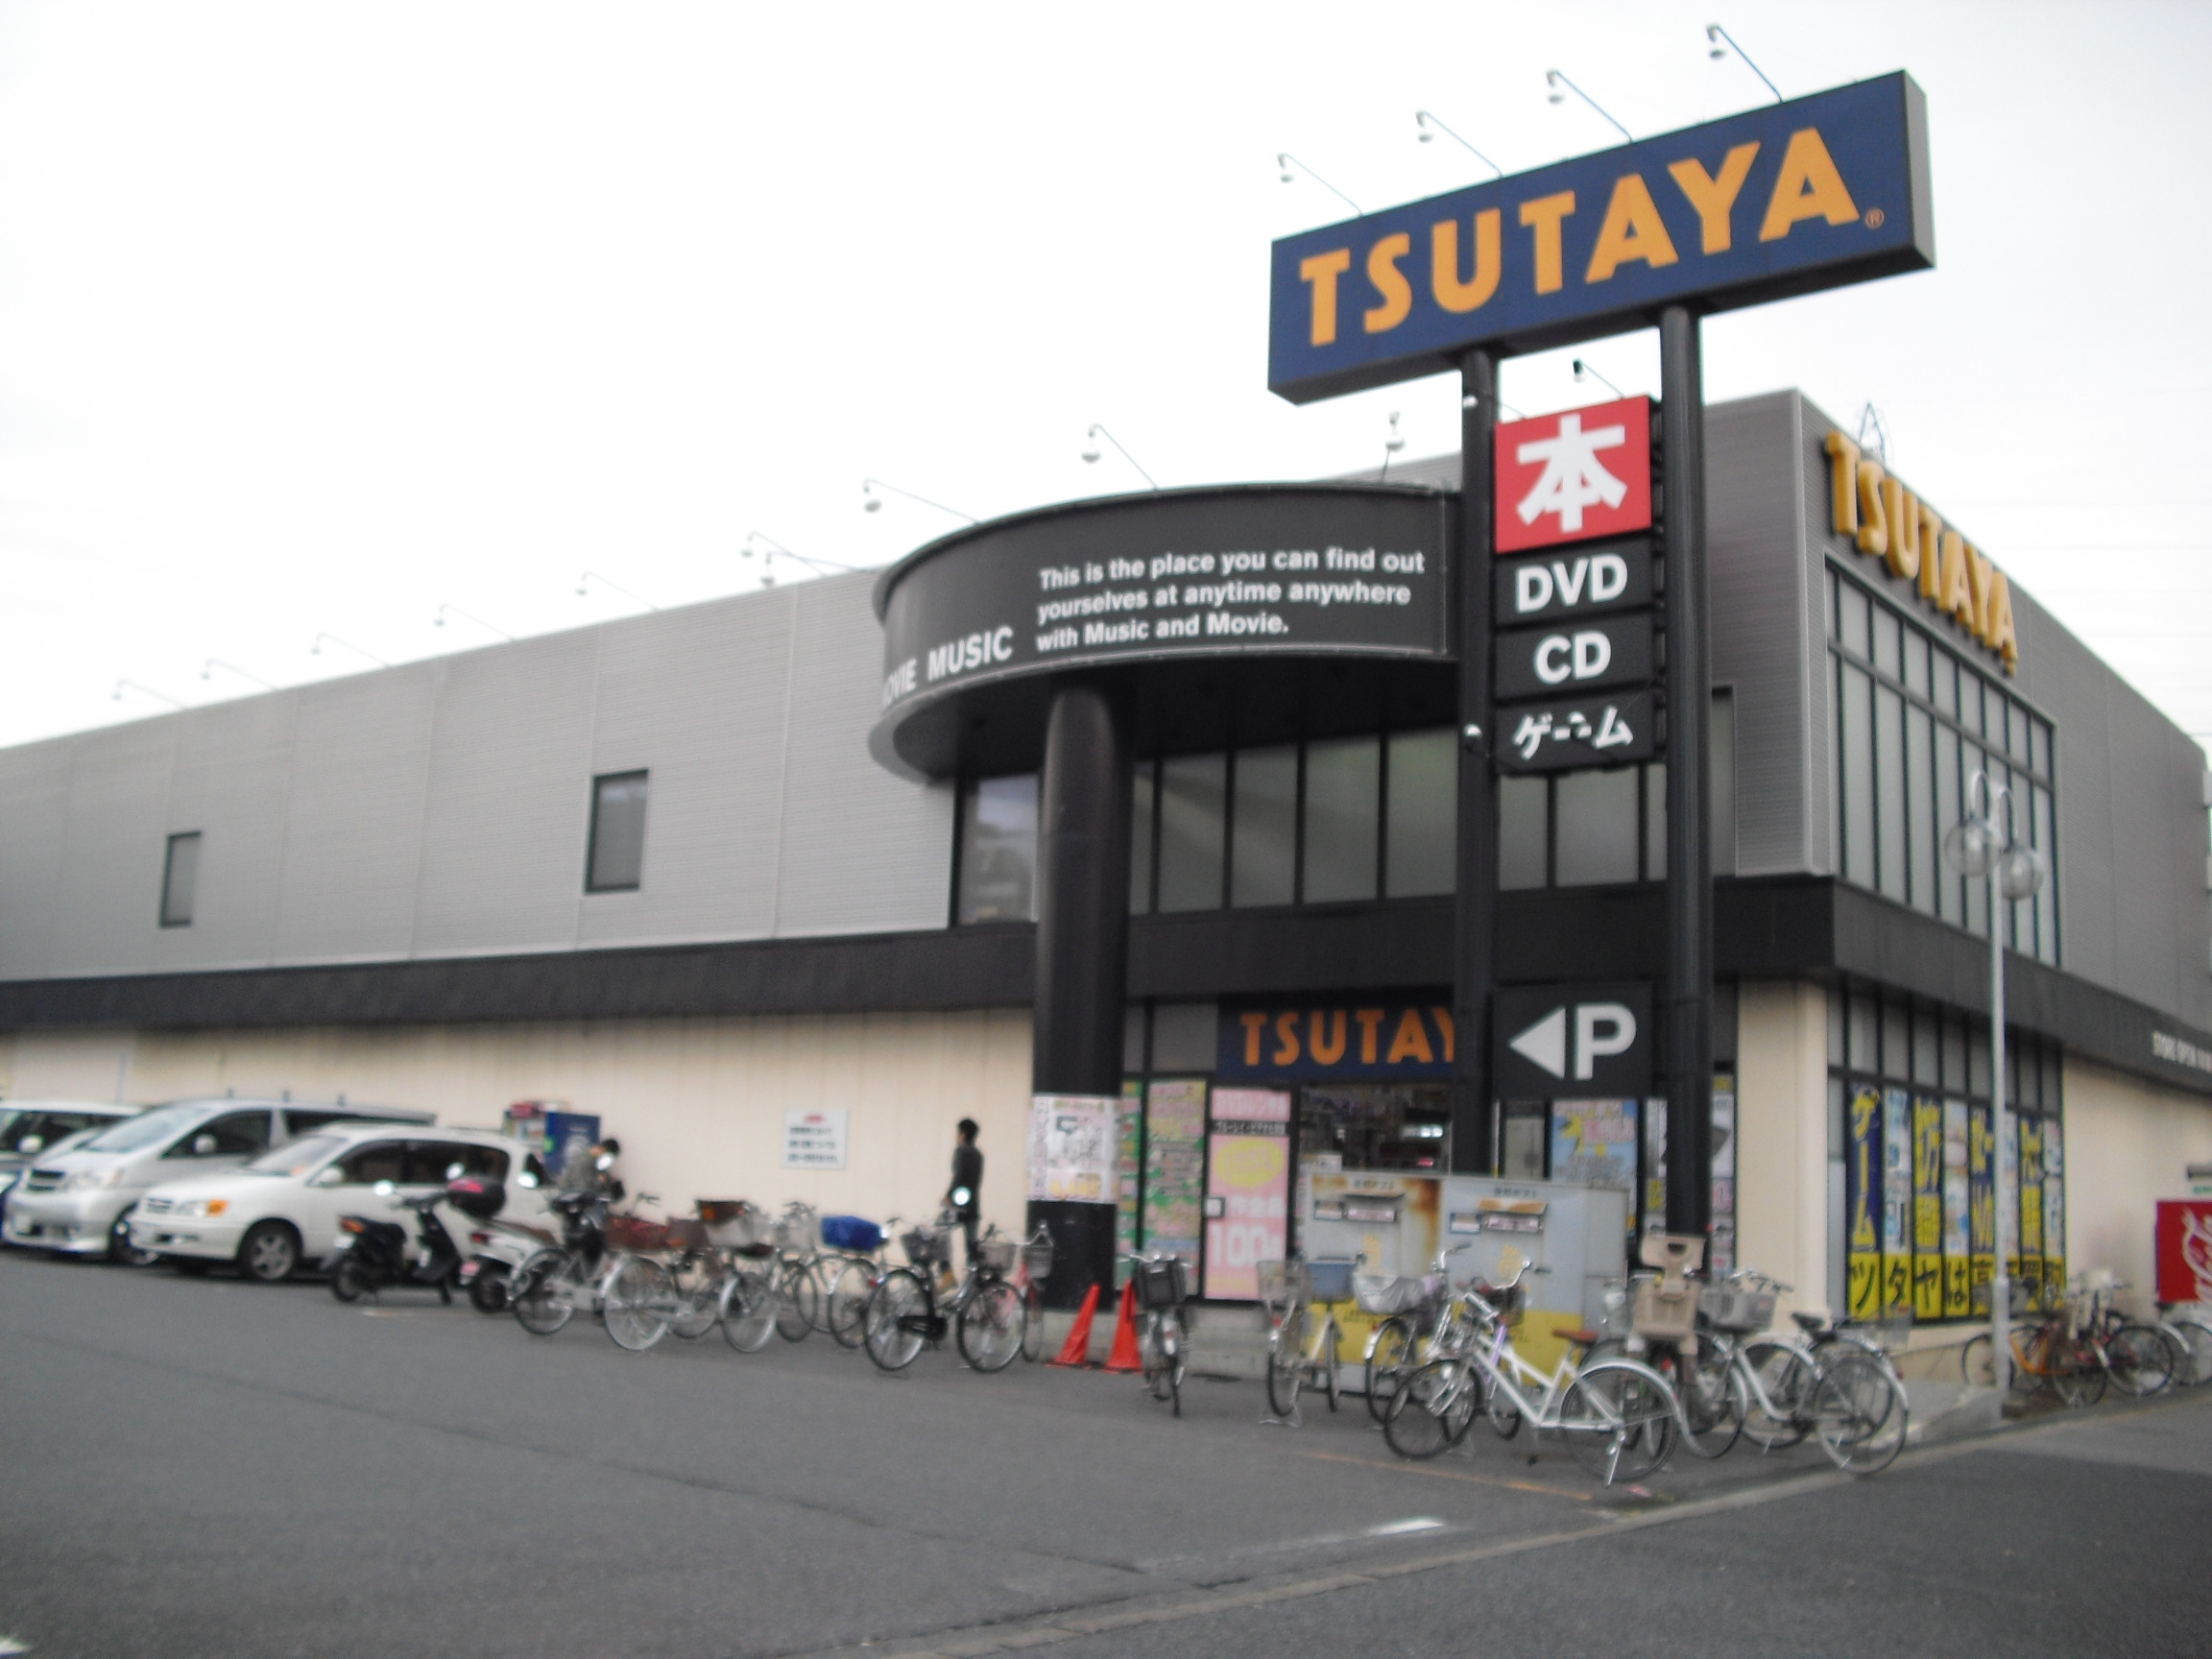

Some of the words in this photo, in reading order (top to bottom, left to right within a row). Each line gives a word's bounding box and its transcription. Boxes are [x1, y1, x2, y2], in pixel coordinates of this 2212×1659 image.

[1299, 127, 1861, 347] TSUTAYA
[1516, 413, 1628, 534] 本
[1040, 565, 1080, 590] This
[1085, 562, 1103, 584] is
[1108, 558, 1146, 580] the
[1150, 552, 1215, 581] place
[1221, 551, 1266, 576] you
[1273, 550, 1319, 570] can
[1325, 545, 1376, 571] find
[1382, 550, 1426, 574] out
[1827, 429, 2018, 675] TSUTAYA
[1038, 589, 1148, 625] yourselves
[1154, 584, 1178, 607] at
[1185, 580, 1282, 608] anytime
[1288, 578, 1411, 607] anywhere
[1516, 554, 1628, 613] DVD
[1036, 626, 1079, 652] with
[1083, 617, 1149, 645] Music
[1155, 613, 1200, 638] and
[1206, 611, 1289, 635] Movie.
[1534, 631, 1612, 684] CD
[883, 658, 917, 709] OVIE
[927, 626, 1014, 682] MUSIC
[1513, 705, 1633, 760] ゲーム
[1241, 1006, 1455, 1067] TSUTAY
[1575, 1002, 1637, 1080] P
